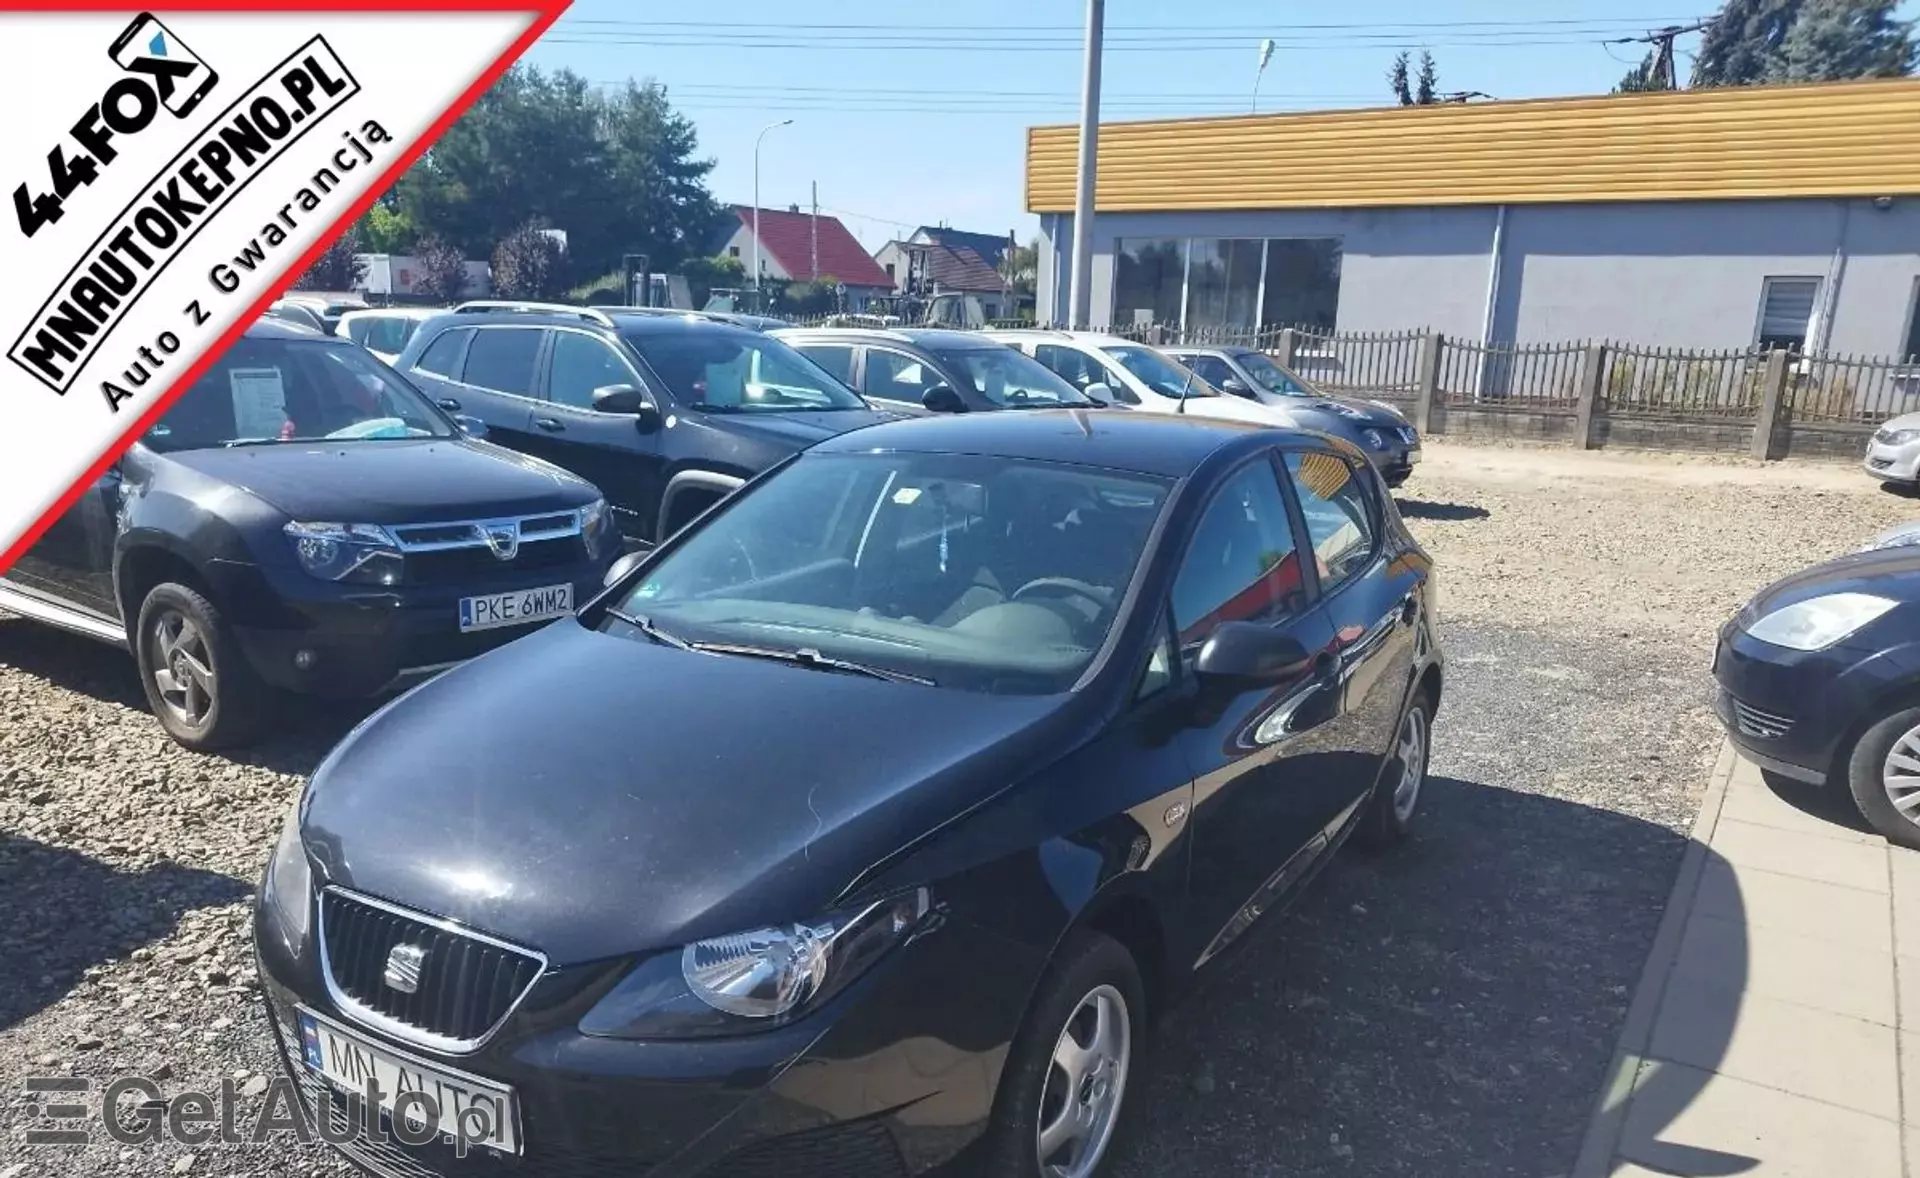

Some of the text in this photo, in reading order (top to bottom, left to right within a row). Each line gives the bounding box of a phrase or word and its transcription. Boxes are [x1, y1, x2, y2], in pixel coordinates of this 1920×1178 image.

[475, 597, 515, 622] PKE
[521, 589, 567, 615] 6WM2
[329, 1034, 497, 1138] MN AUTO
